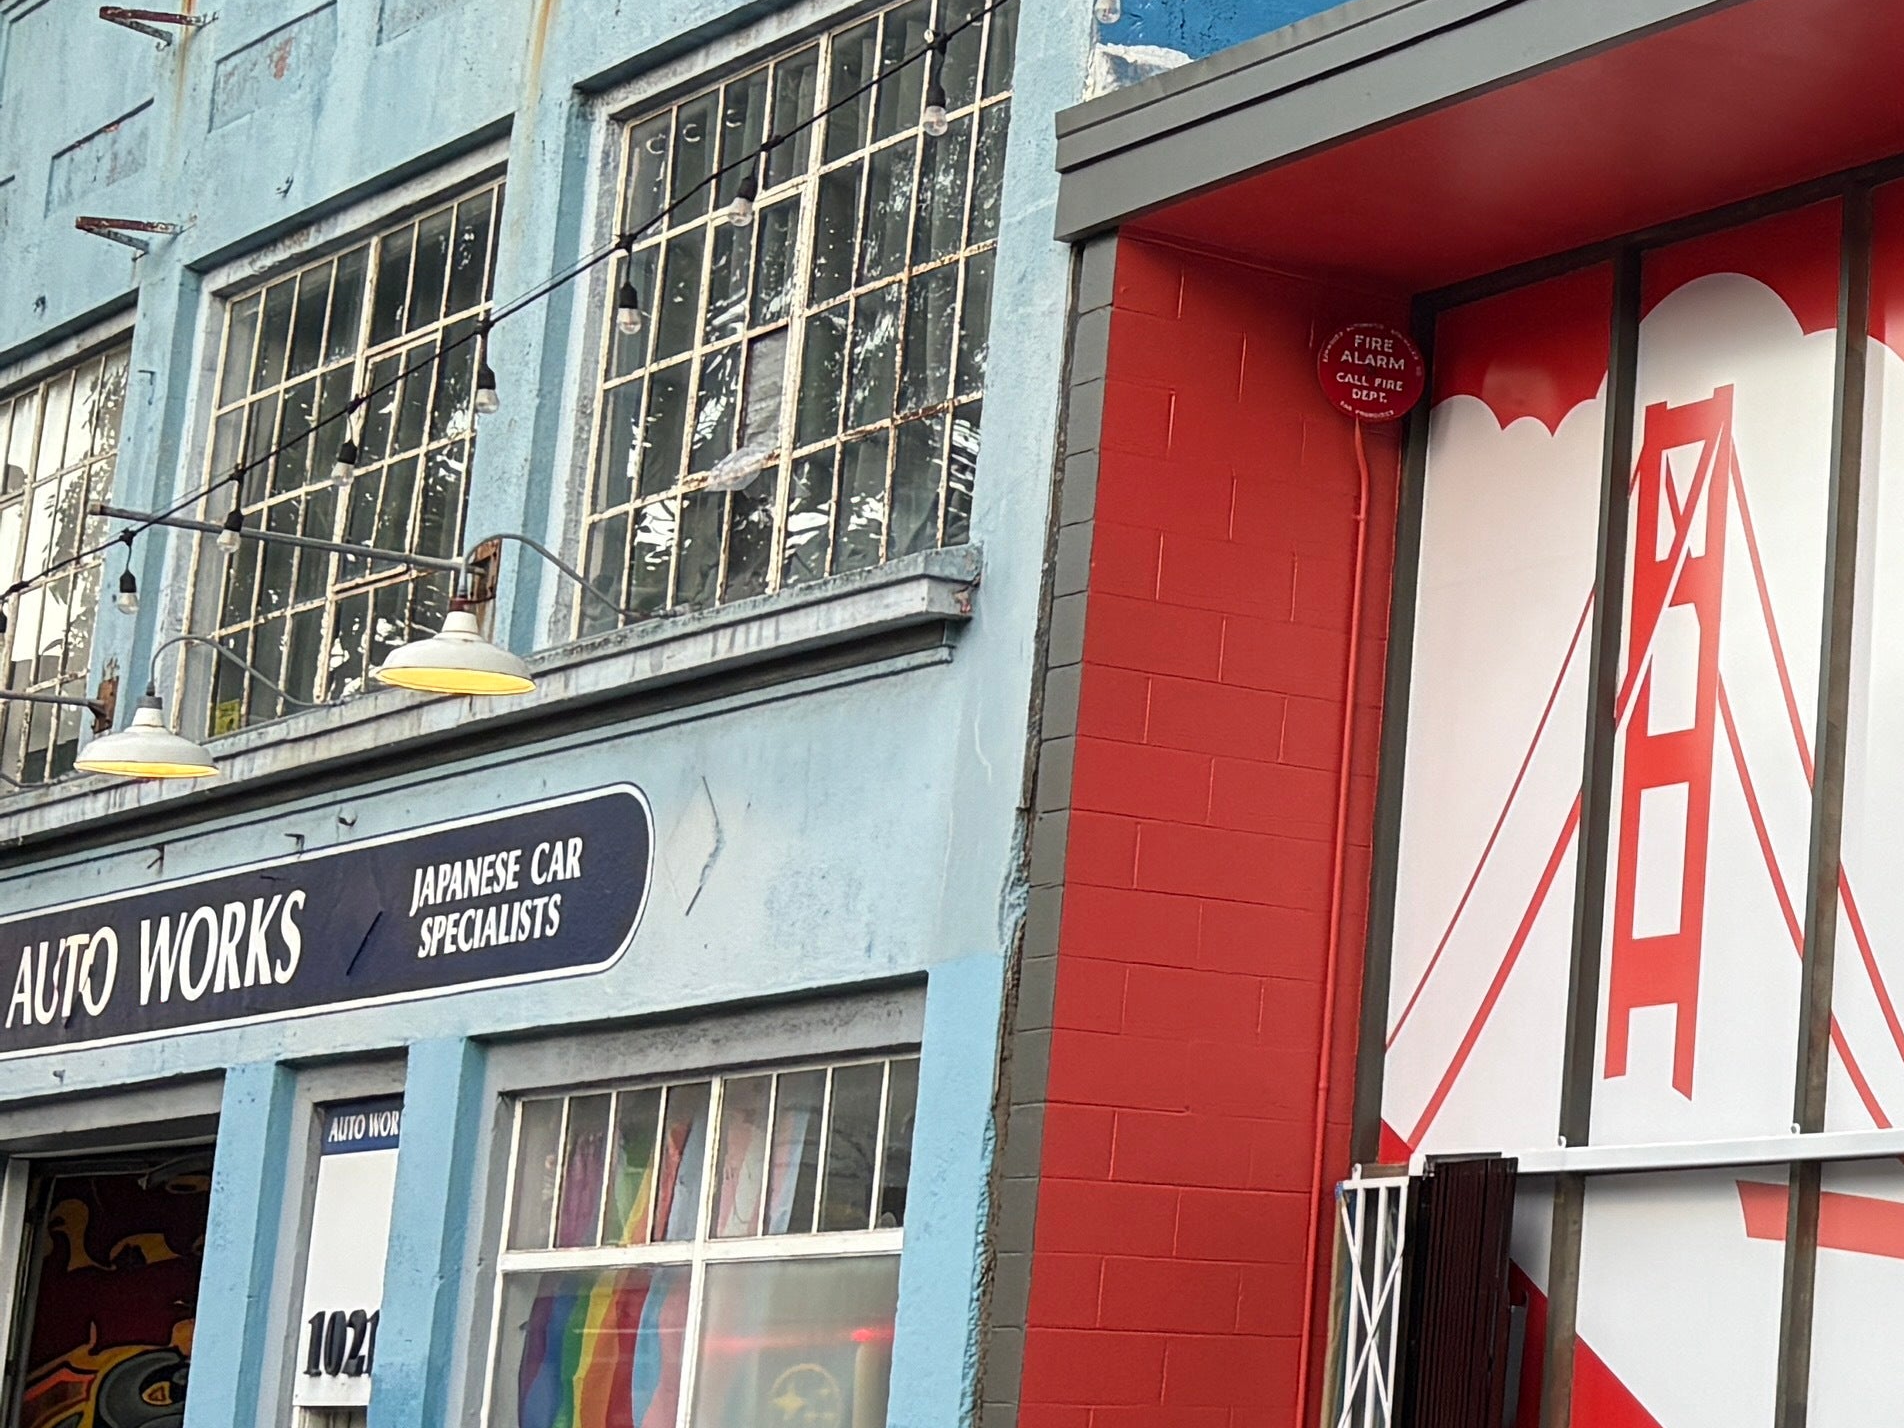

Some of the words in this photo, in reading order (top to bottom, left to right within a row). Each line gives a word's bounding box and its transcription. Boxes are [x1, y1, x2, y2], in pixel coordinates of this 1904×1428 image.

[1355, 335, 1394, 352] FIRE
[1340, 350, 1405, 370] ALARM
[1336, 372, 1369, 387] CALL
[1374, 378, 1403, 391] FIRE
[1352, 388, 1388, 403] DEPT.
[409, 848, 522, 917] JAPANESE
[530, 836, 584, 887] CAR
[417, 894, 562, 959] SPECIALISTS
[5, 927, 119, 1029] AUTO
[137, 889, 307, 1007] WORKS
[328, 1113, 366, 1143] AUTO
